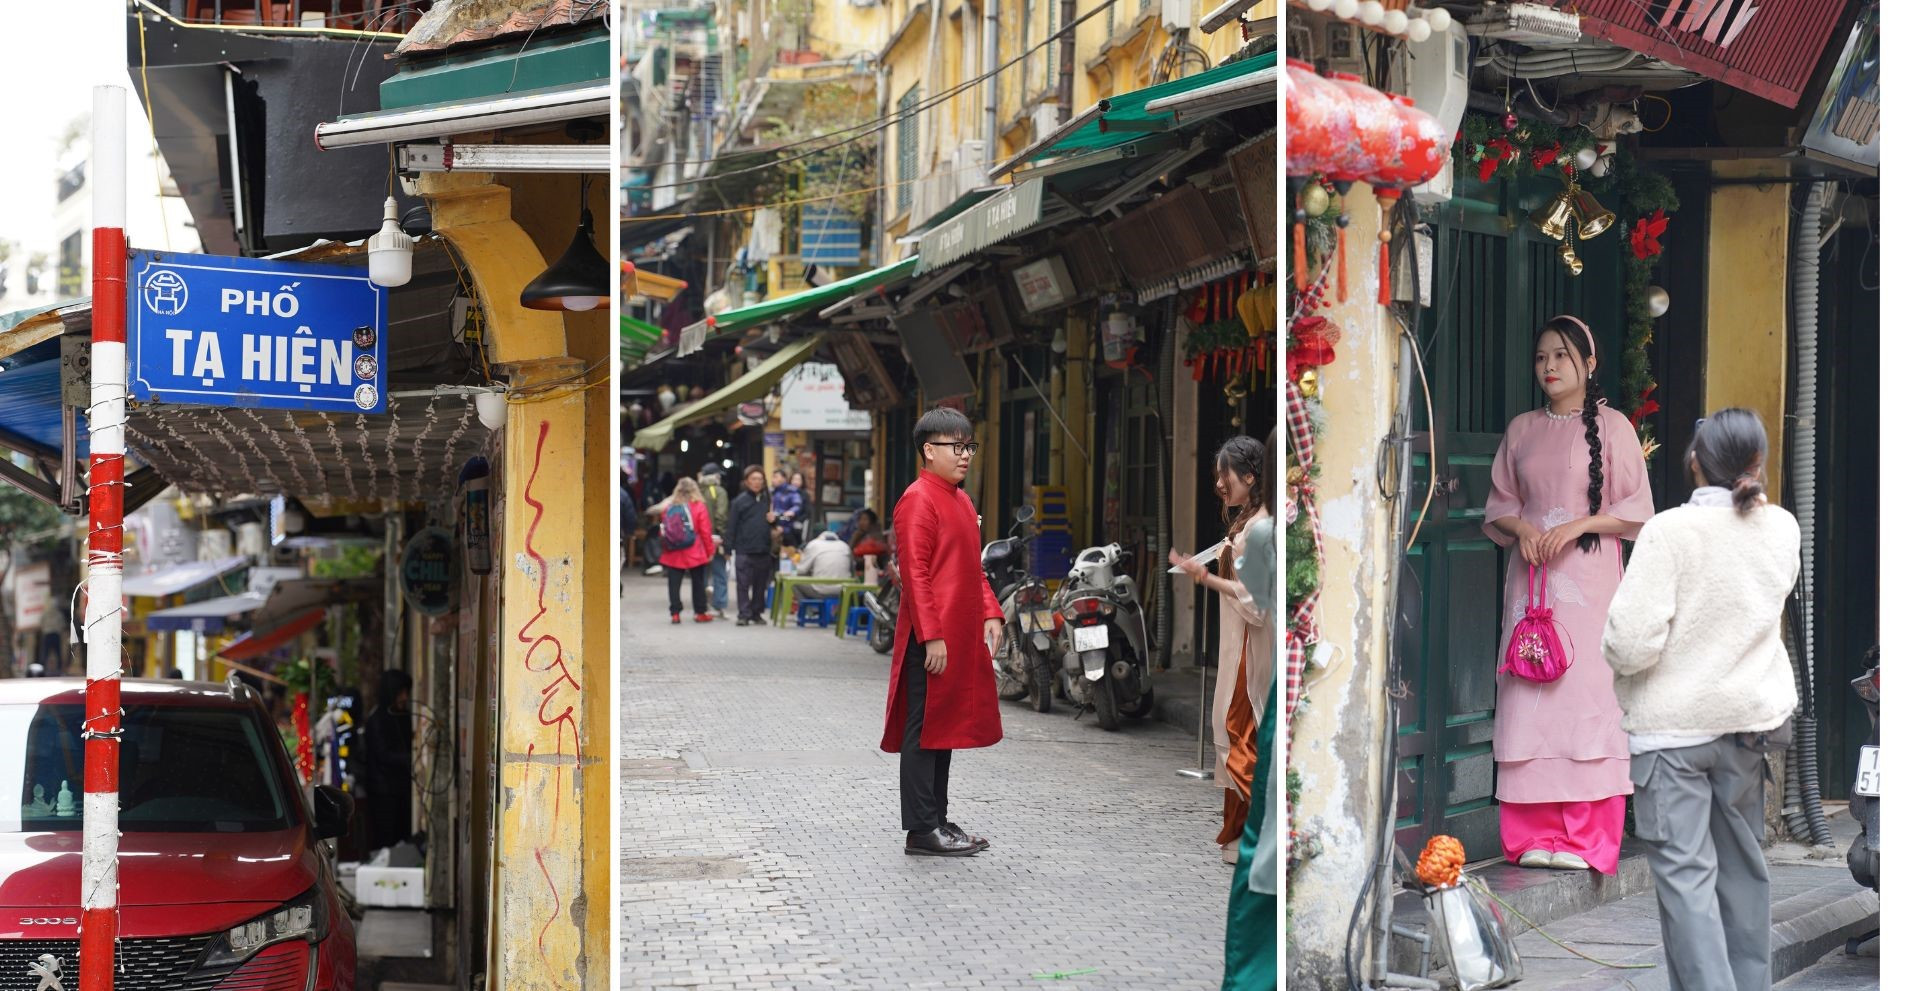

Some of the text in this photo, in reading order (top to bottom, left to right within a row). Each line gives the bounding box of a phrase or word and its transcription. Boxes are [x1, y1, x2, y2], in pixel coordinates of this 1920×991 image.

[221, 282, 301, 318] PHỐ
[165, 329, 225, 386] TẠ
[242, 326, 352, 393] HIỆN
